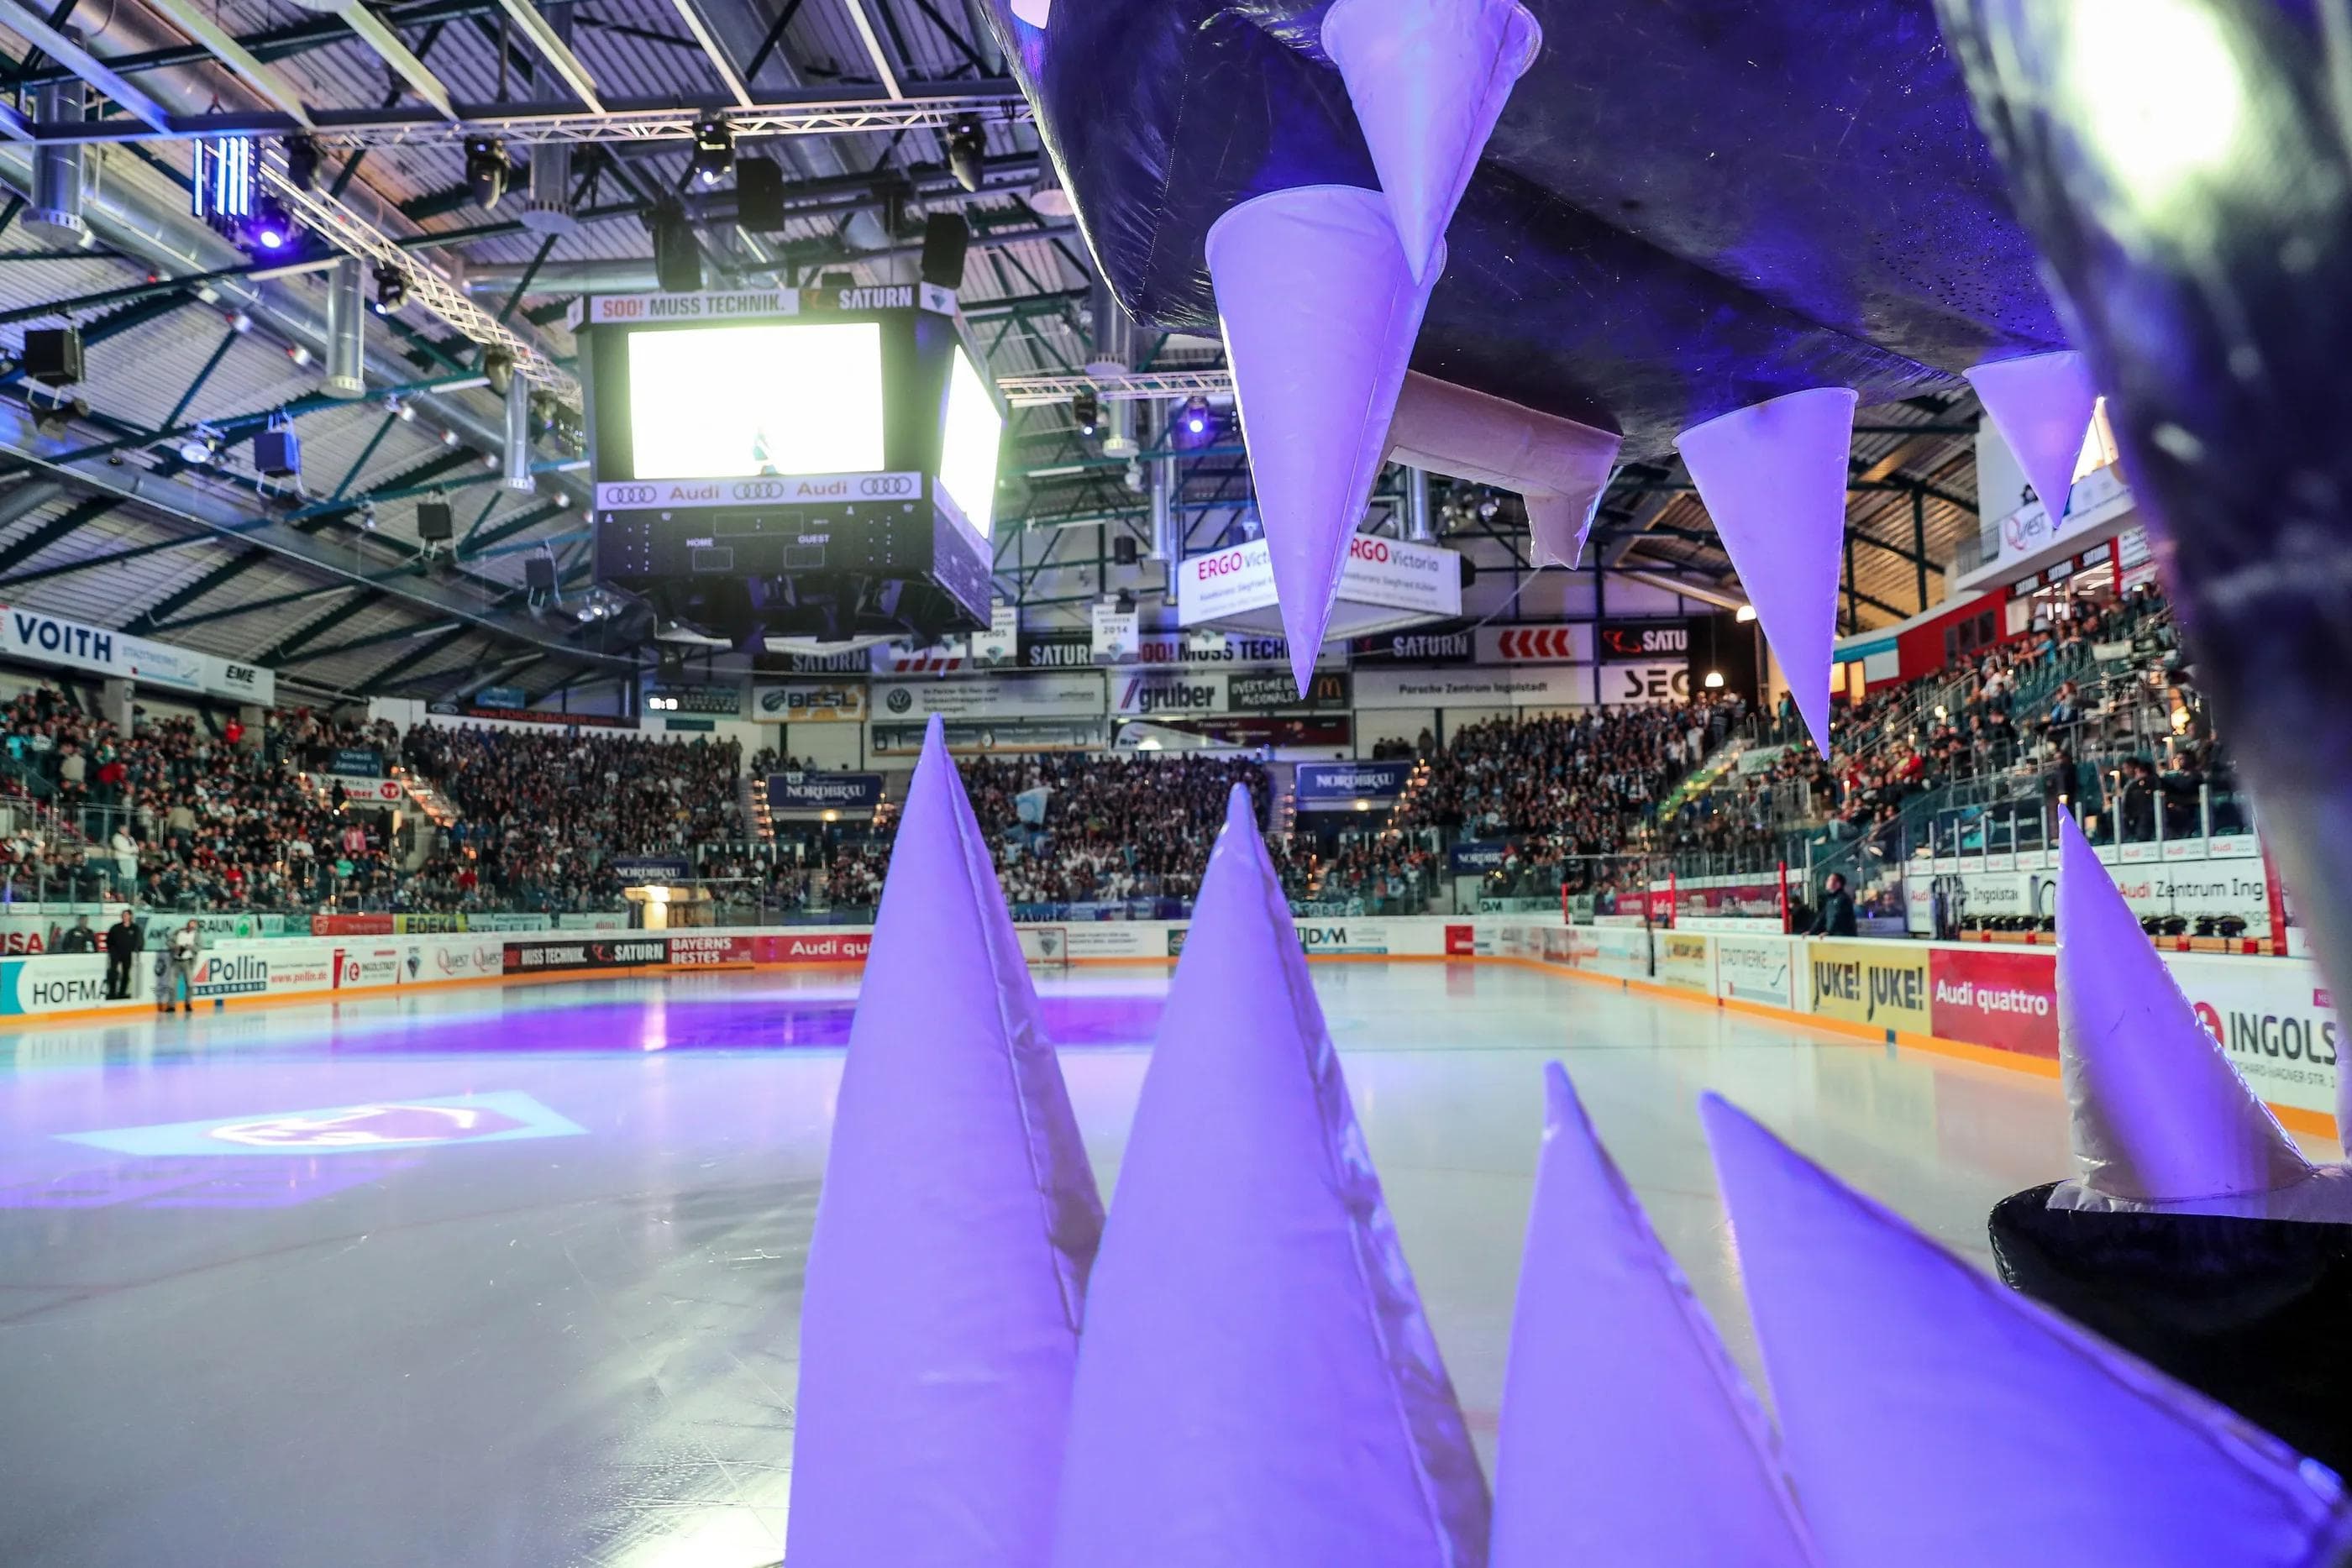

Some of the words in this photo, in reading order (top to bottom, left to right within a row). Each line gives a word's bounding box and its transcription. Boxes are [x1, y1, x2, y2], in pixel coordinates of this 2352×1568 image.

[602, 299, 643, 317] SOO!
[649, 297, 701, 316] MUSS
[706, 294, 785, 313] TECHNIK.
[839, 286, 913, 310] SATURN
[669, 485, 719, 501] Audi
[796, 480, 848, 496] Audi
[686, 538, 714, 547] HOME
[798, 534, 830, 544] GUEST
[1199, 552, 1242, 580] ERGO
[1245, 548, 1270, 569] Vict
[1350, 538, 1389, 564] RGO
[1391, 548, 1439, 572] Victoria
[14, 613, 112, 663] VOITH
[1393, 636, 1467, 658] SATURN
[1642, 630, 1688, 652] SATU
[792, 651, 866, 673] SATURN
[1030, 645, 1092, 665] SATUR
[1137, 642, 1174, 662] OO!
[1139, 684, 1215, 712] gruber
[1399, 684, 1442, 694] Porsche
[1446, 683, 1492, 694] Zentrum
[1494, 681, 1548, 696] Ingolstadt
[2118, 882, 2151, 898] Audi
[2155, 881, 2227, 898] Zentrum
[2231, 878, 2263, 901] Ing
[199, 920, 234, 933] RAUN
[1309, 928, 1347, 944] DVM
[615, 943, 664, 962] SATURN
[672, 937, 732, 950] BAYERNS
[790, 941, 837, 956] Audi
[672, 951, 720, 963] BESTES
[209, 956, 267, 982] Pollin
[1814, 961, 1861, 1012] JUKE!
[1867, 966, 1924, 1022] JUKE!
[1935, 979, 1973, 1006] Audi
[1977, 986, 2050, 1016] quattro
